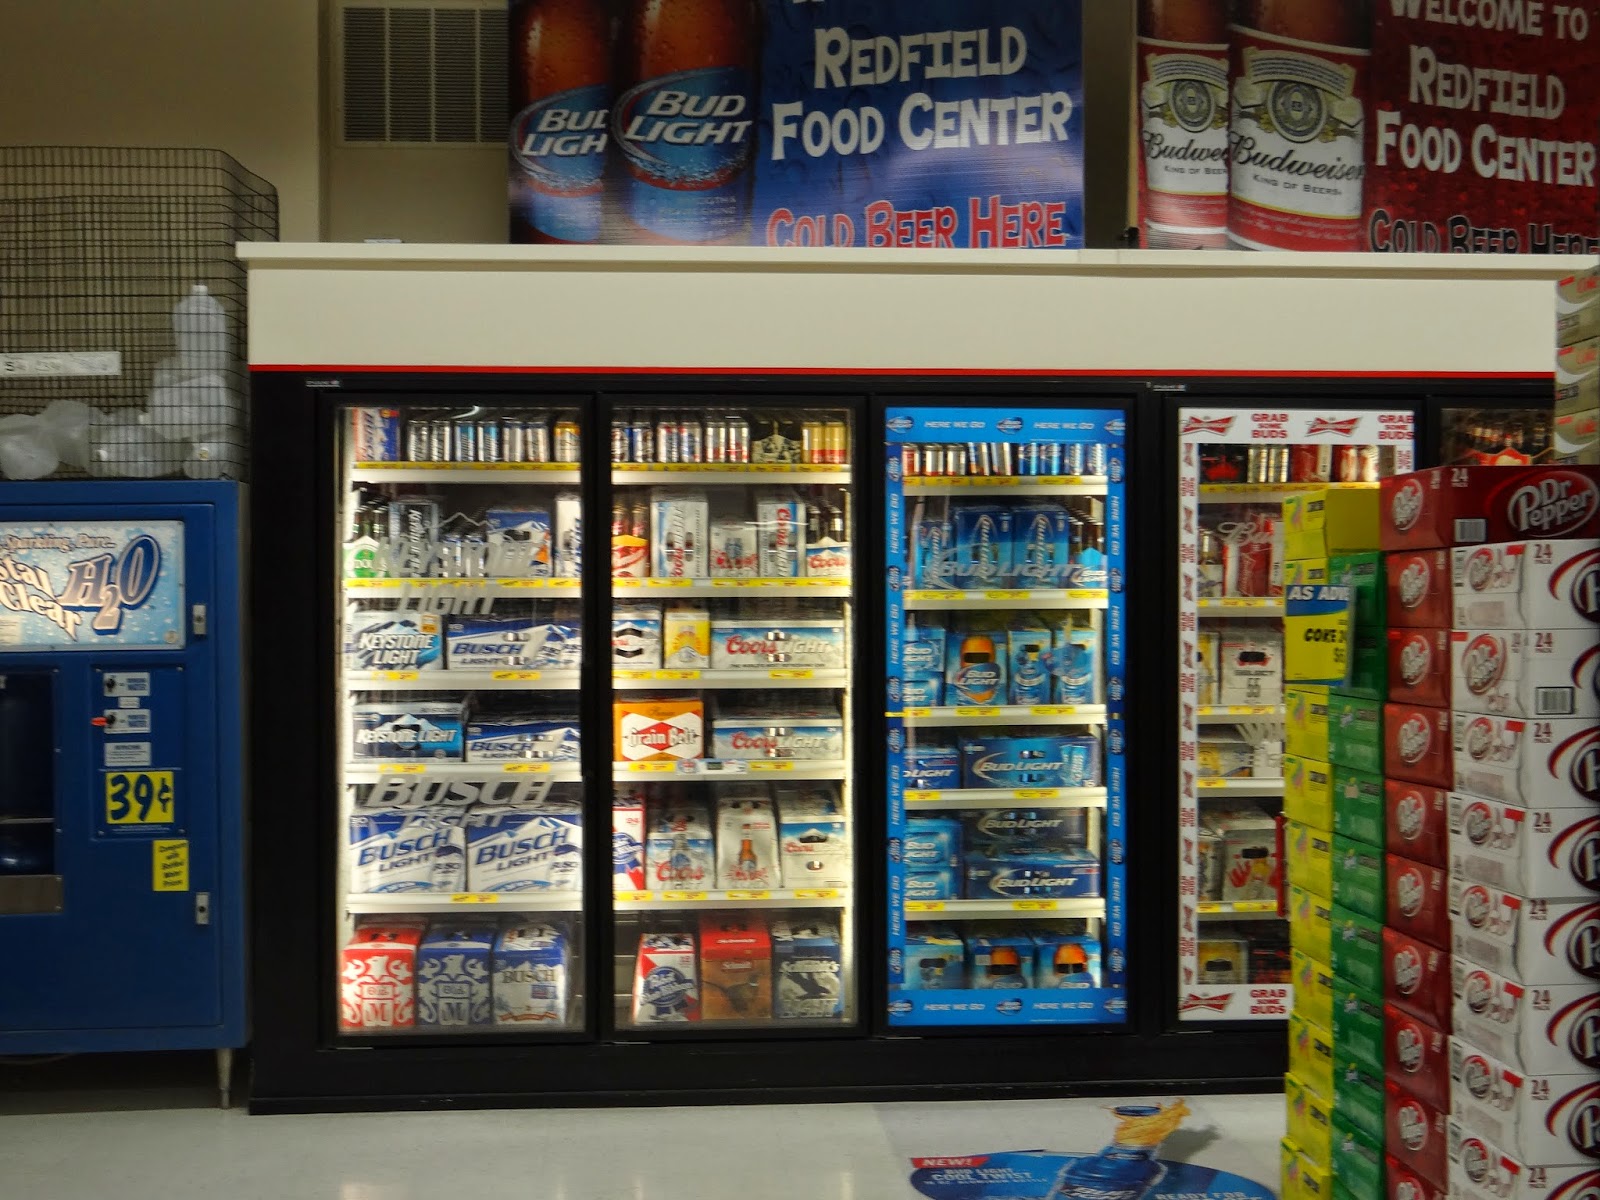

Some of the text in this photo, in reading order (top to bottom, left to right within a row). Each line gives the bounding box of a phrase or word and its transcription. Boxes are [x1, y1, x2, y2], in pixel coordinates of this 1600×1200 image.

[1552, 5, 1590, 41] TO
[814, 26, 1028, 89] REDFIELD
[1409, 44, 1566, 119] REDFIELD
[647, 90, 747, 117] BUD
[624, 115, 753, 144] LIGHT
[771, 92, 1073, 161] FOOD CENTER
[1229, 127, 1366, 181] Budweiser
[1375, 109, 1597, 187] FOOD CENTER
[1252, 174, 1279, 187] KING
[1283, 180, 1298, 189] OF
[864, 199, 959, 248] BEER
[967, 195, 1067, 249] HERE
[1250, 413, 1289, 422] GRAB
[1377, 415, 1413, 424] GRAB
[1250, 429, 1288, 438] BUDS
[1377, 431, 1413, 440] BUDS
[1451, 468, 1469, 481] 24
[1539, 478, 1572, 506] Dr
[1513, 484, 1594, 531] Pepper
[1534, 543, 1554, 559] 24
[1288, 586, 1315, 601] AS
[358, 632, 434, 651] KEYSTONE
[725, 634, 778, 655] Coors
[1534, 632, 1554, 647] 24
[452, 642, 525, 655] BUSCH
[372, 648, 423, 666] LIGHT
[964, 669, 997, 678] BUD
[960, 678, 1000, 686] LIGHT
[356, 728, 459, 744] KEYSTONE LIGHT
[1534, 722, 1553, 737] 24
[470, 741, 536, 751] BUSCH
[910, 768, 955, 779] LIGHT
[979, 761, 1065, 772] BUD LIGHT
[364, 772, 557, 808] BUSCH
[984, 819, 1064, 829] BUD LIGHT
[1533, 812, 1552, 827] 24
[358, 829, 452, 866] BUSCH
[476, 828, 571, 865] BUSCH
[497, 852, 549, 871] LIGHT
[997, 877, 1078, 887] BUD LIGHT
[1529, 900, 1548, 915] 24
[501, 969, 557, 984] BUSCH
[1250, 988, 1287, 998] GRAB
[1532, 990, 1552, 1005] 24
[1250, 1005, 1287, 1014] BUDS
[1531, 1080, 1551, 1095] 24
[923, 1158, 974, 1167] NEW!
[930, 1172, 1034, 1181] COOL TWIST
[1528, 1167, 1548, 1182] 24
